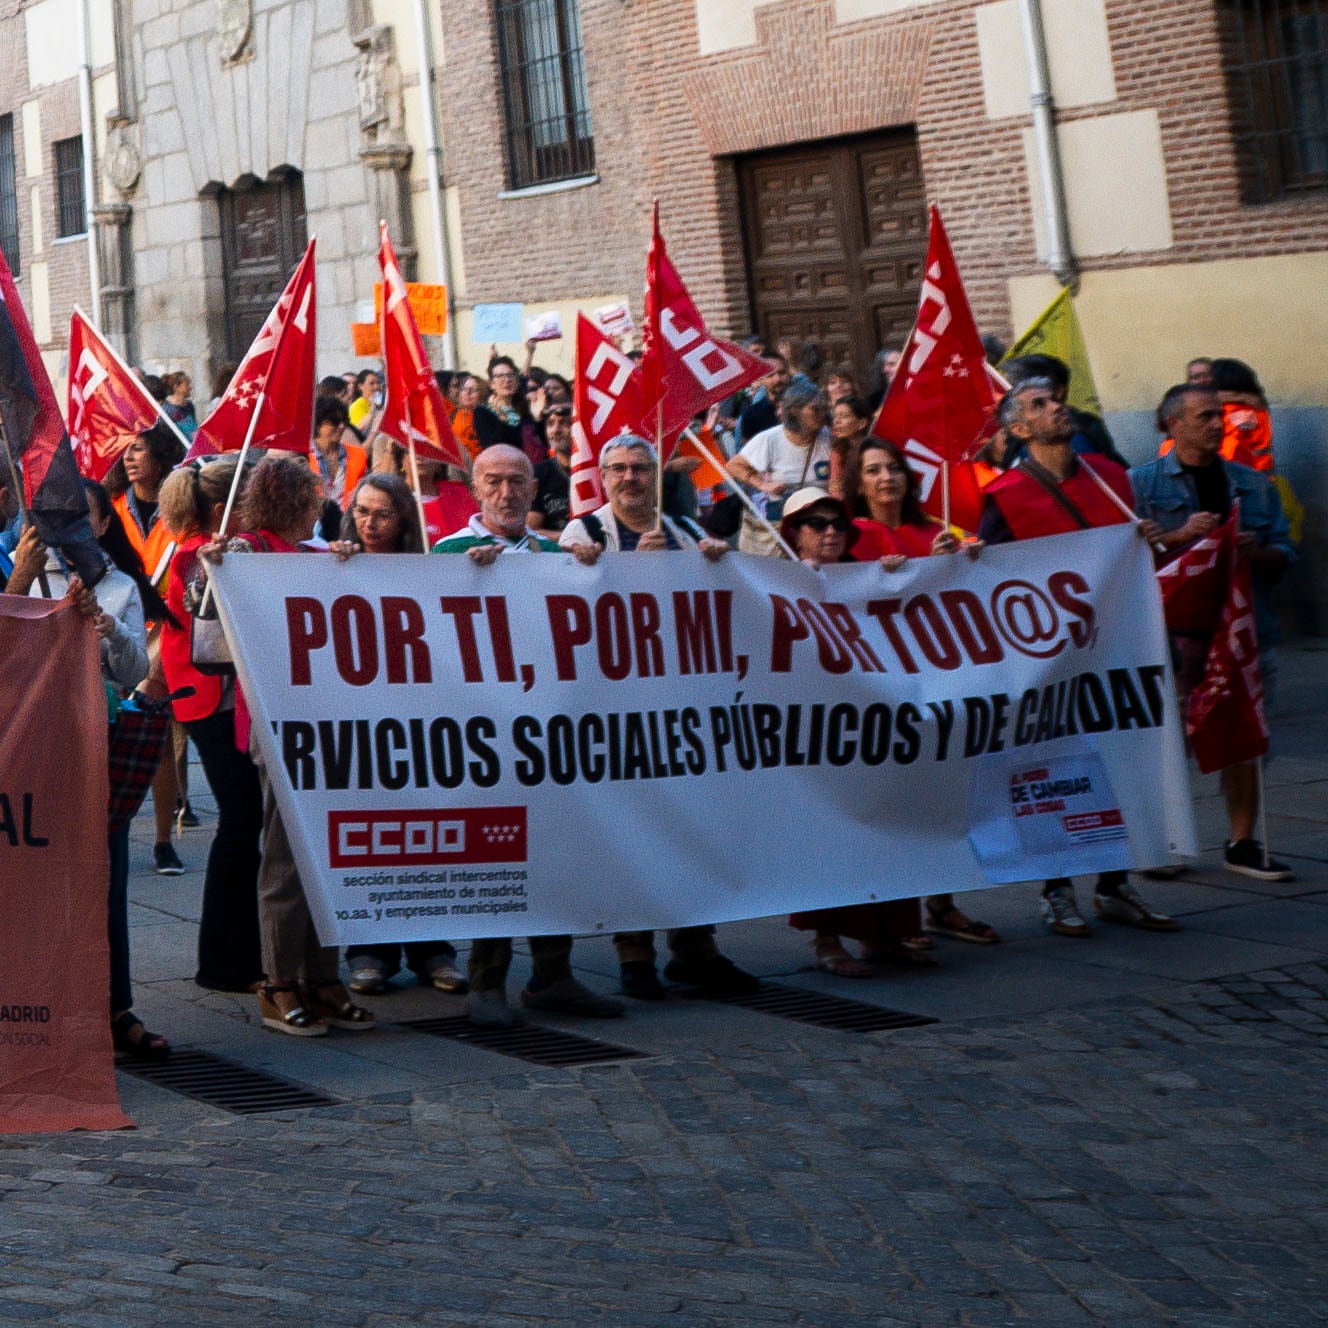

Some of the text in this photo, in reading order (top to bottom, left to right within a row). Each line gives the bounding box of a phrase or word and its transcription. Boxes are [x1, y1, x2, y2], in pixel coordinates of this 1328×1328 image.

[285, 594, 433, 687] POR
[440, 595, 535, 693] TI,
[545, 591, 666, 681] POR
[671, 589, 749, 681] MI,
[769, 593, 887, 673] POR
[270, 715, 501, 791] RVICIOS
[512, 706, 706, 789] SOCIALES
[709, 671, 923, 773] PÚBLICOS
[926, 700, 955, 762] Y
[962, 693, 1010, 758] DE
[1011, 785, 1030, 803] DE
[338, 820, 466, 855] CCOO
[342, 867, 528, 887] sección sindical intercentros
[368, 882, 528, 904] ayuntamiento de madrid,
[374, 907, 383, 921] y
[385, 904, 448, 919] empresas
[451, 901, 528, 915] municipales
